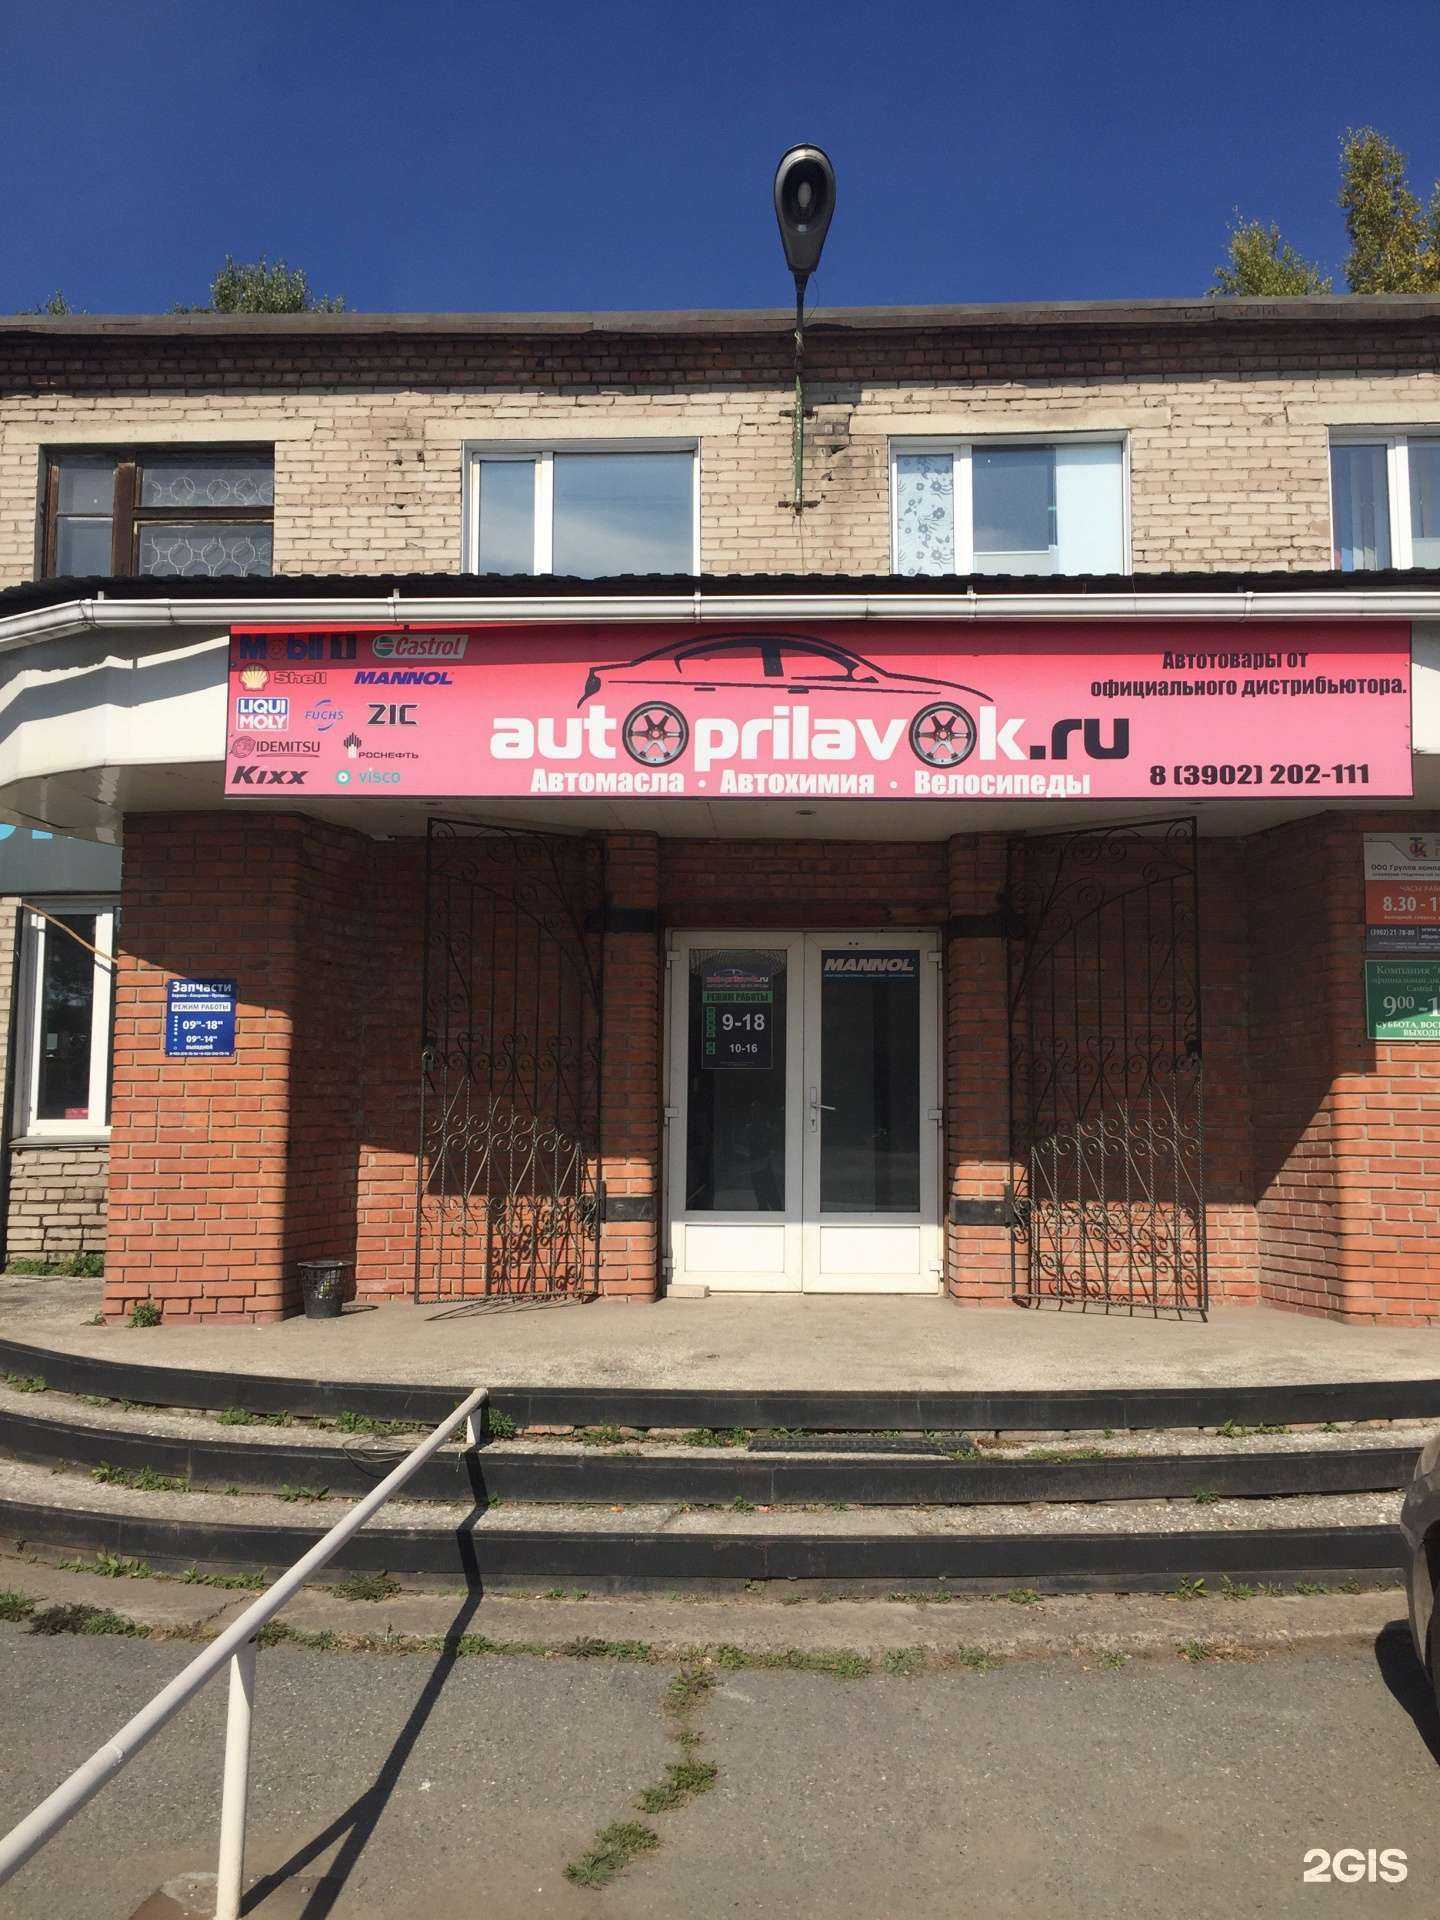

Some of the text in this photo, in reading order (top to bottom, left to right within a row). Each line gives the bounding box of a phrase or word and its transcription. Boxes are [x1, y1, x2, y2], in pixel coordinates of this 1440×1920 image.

[396, 636, 461, 656] Castrol
[1162, 651, 1308, 670] Автотовары от
[273, 671, 327, 685] Shell
[354, 671, 453, 685] MANNOL
[1090, 676, 1408, 698] официального дистрибьютора.
[239, 699, 287, 715] LIQUI
[304, 710, 344, 720] FUCHS
[367, 703, 418, 725] ZIC
[239, 714, 287, 730] MOLY
[255, 740, 321, 753] IDEMITSU
[358, 751, 419, 759] РОСНЕФТЬ
[530, 768, 1091, 797] Автомасла Автохимия Велосипеды
[1149, 763, 1370, 786] 8 (3902) 202-111
[1383, 895, 1417, 912] 8.30
[823, 958, 915, 972] MANNOL
[172, 981, 232, 993] Запчасти
[173, 1002, 230, 1010] РЕЖИМ РАБОТЫ
[722, 1014, 765, 1031] 9-18
[729, 1043, 758, 1054] 10-16
